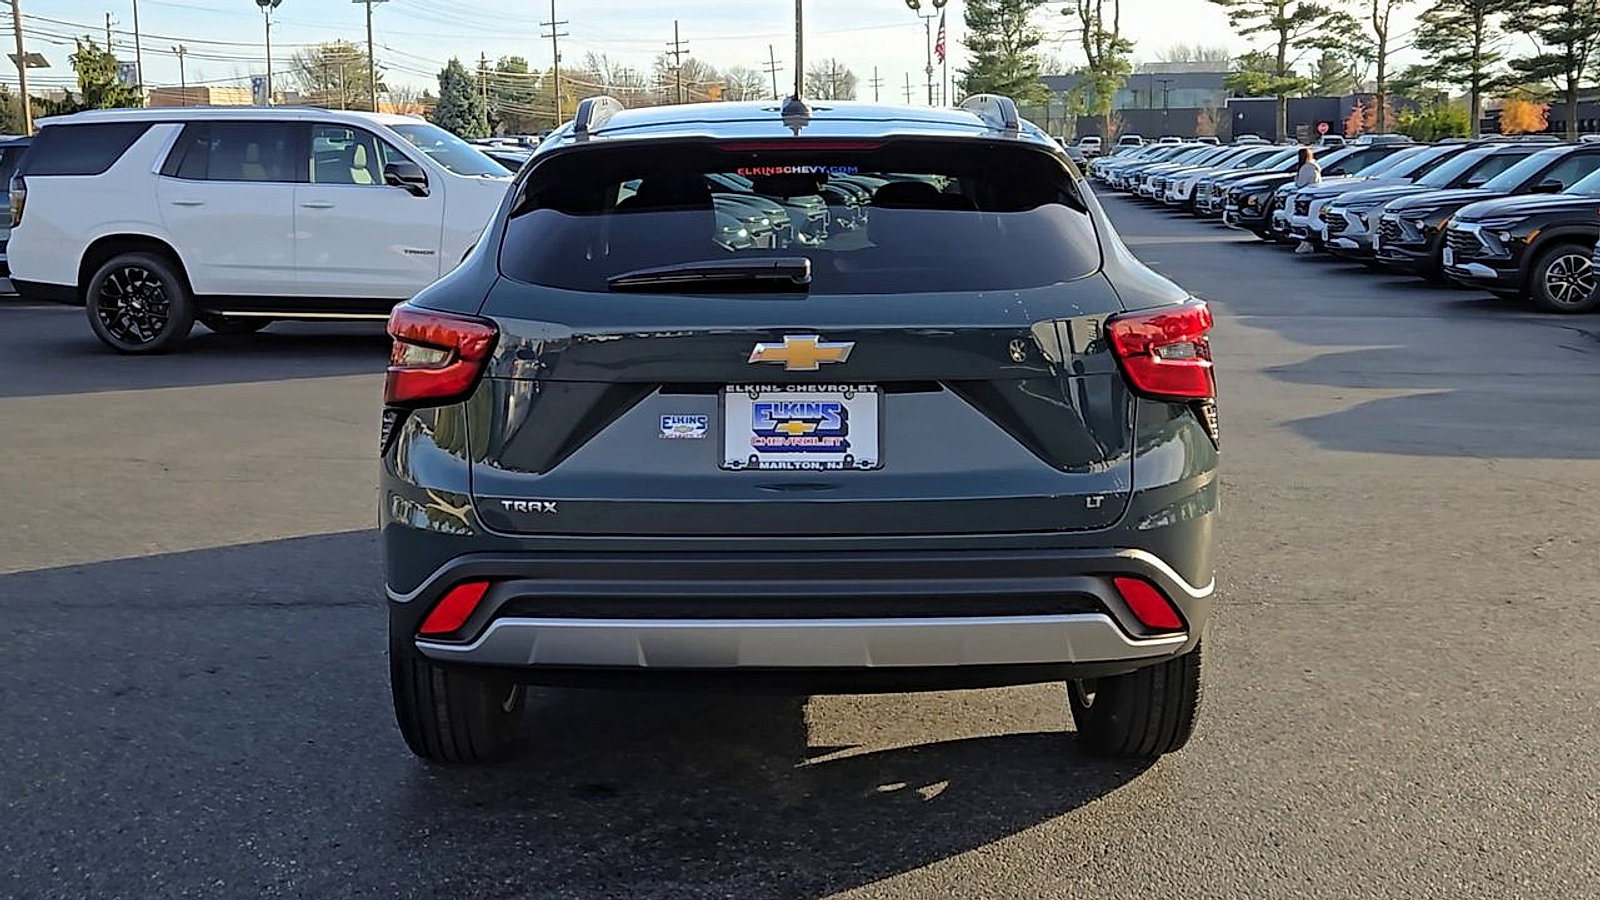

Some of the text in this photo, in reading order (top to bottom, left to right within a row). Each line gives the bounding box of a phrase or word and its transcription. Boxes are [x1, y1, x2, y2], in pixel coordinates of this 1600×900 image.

[737, 165, 858, 175] ELKINSCHEVY.COM
[725, 384, 878, 392] ELKINS CHEVROLET
[752, 402, 843, 430] ELKINS
[662, 416, 707, 429] ELKINS
[751, 436, 844, 447] CHEVROLET
[827, 461, 844, 469] NJ
[501, 500, 558, 513] TRAX
[1086, 495, 1105, 508] LT
